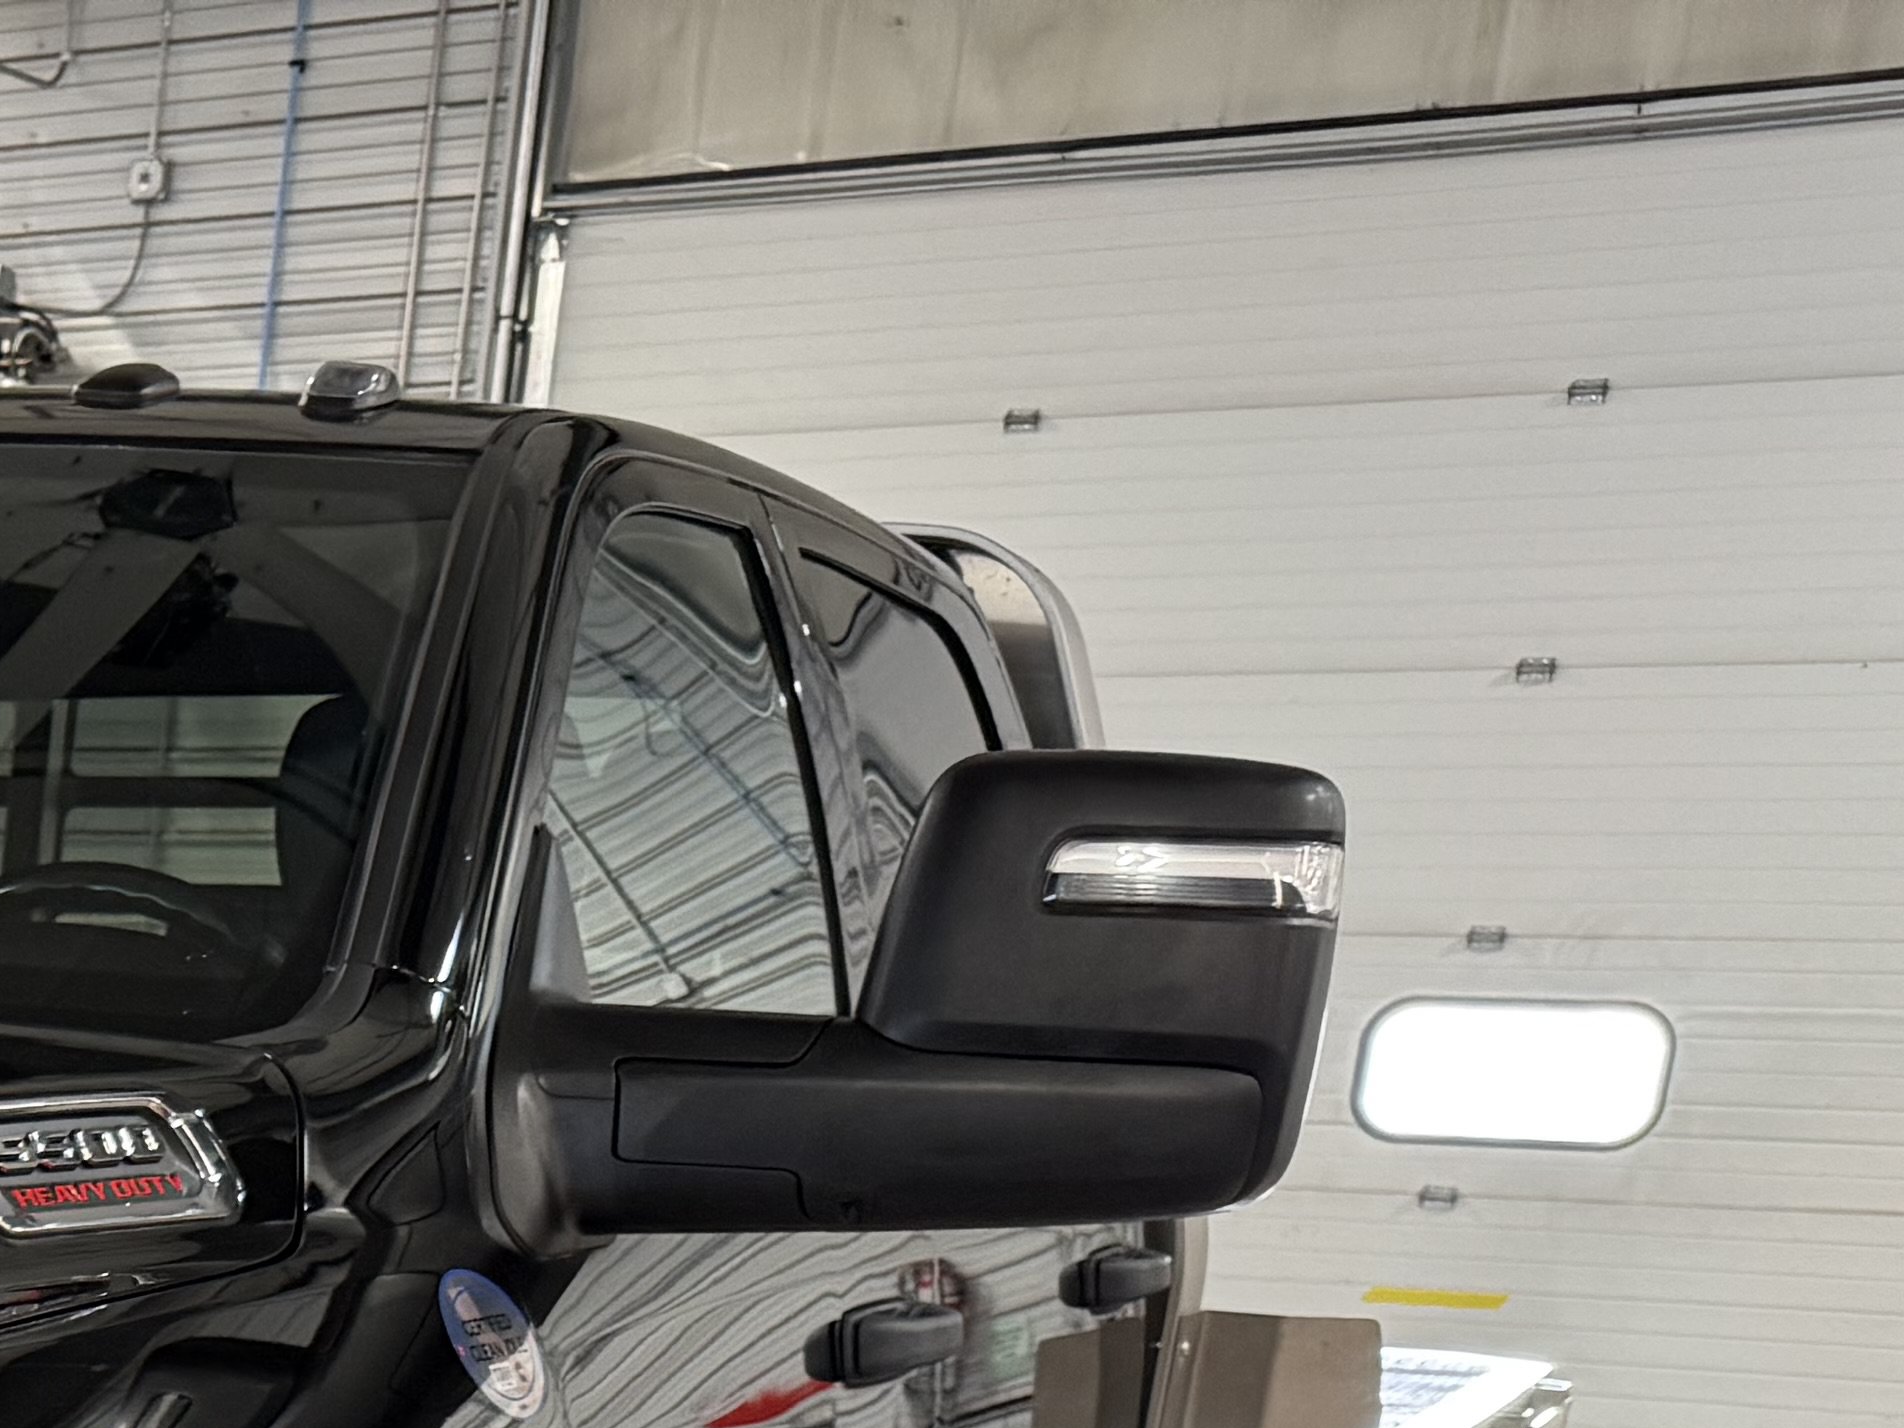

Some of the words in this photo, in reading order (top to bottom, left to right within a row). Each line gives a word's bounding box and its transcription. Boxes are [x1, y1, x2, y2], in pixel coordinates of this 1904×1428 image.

[11, 1180, 107, 1209] HEAVY
[109, 1172, 184, 1200] DUTY
[462, 1313, 512, 1337] CERTIFIED
[469, 1341, 508, 1362] CLEAN
